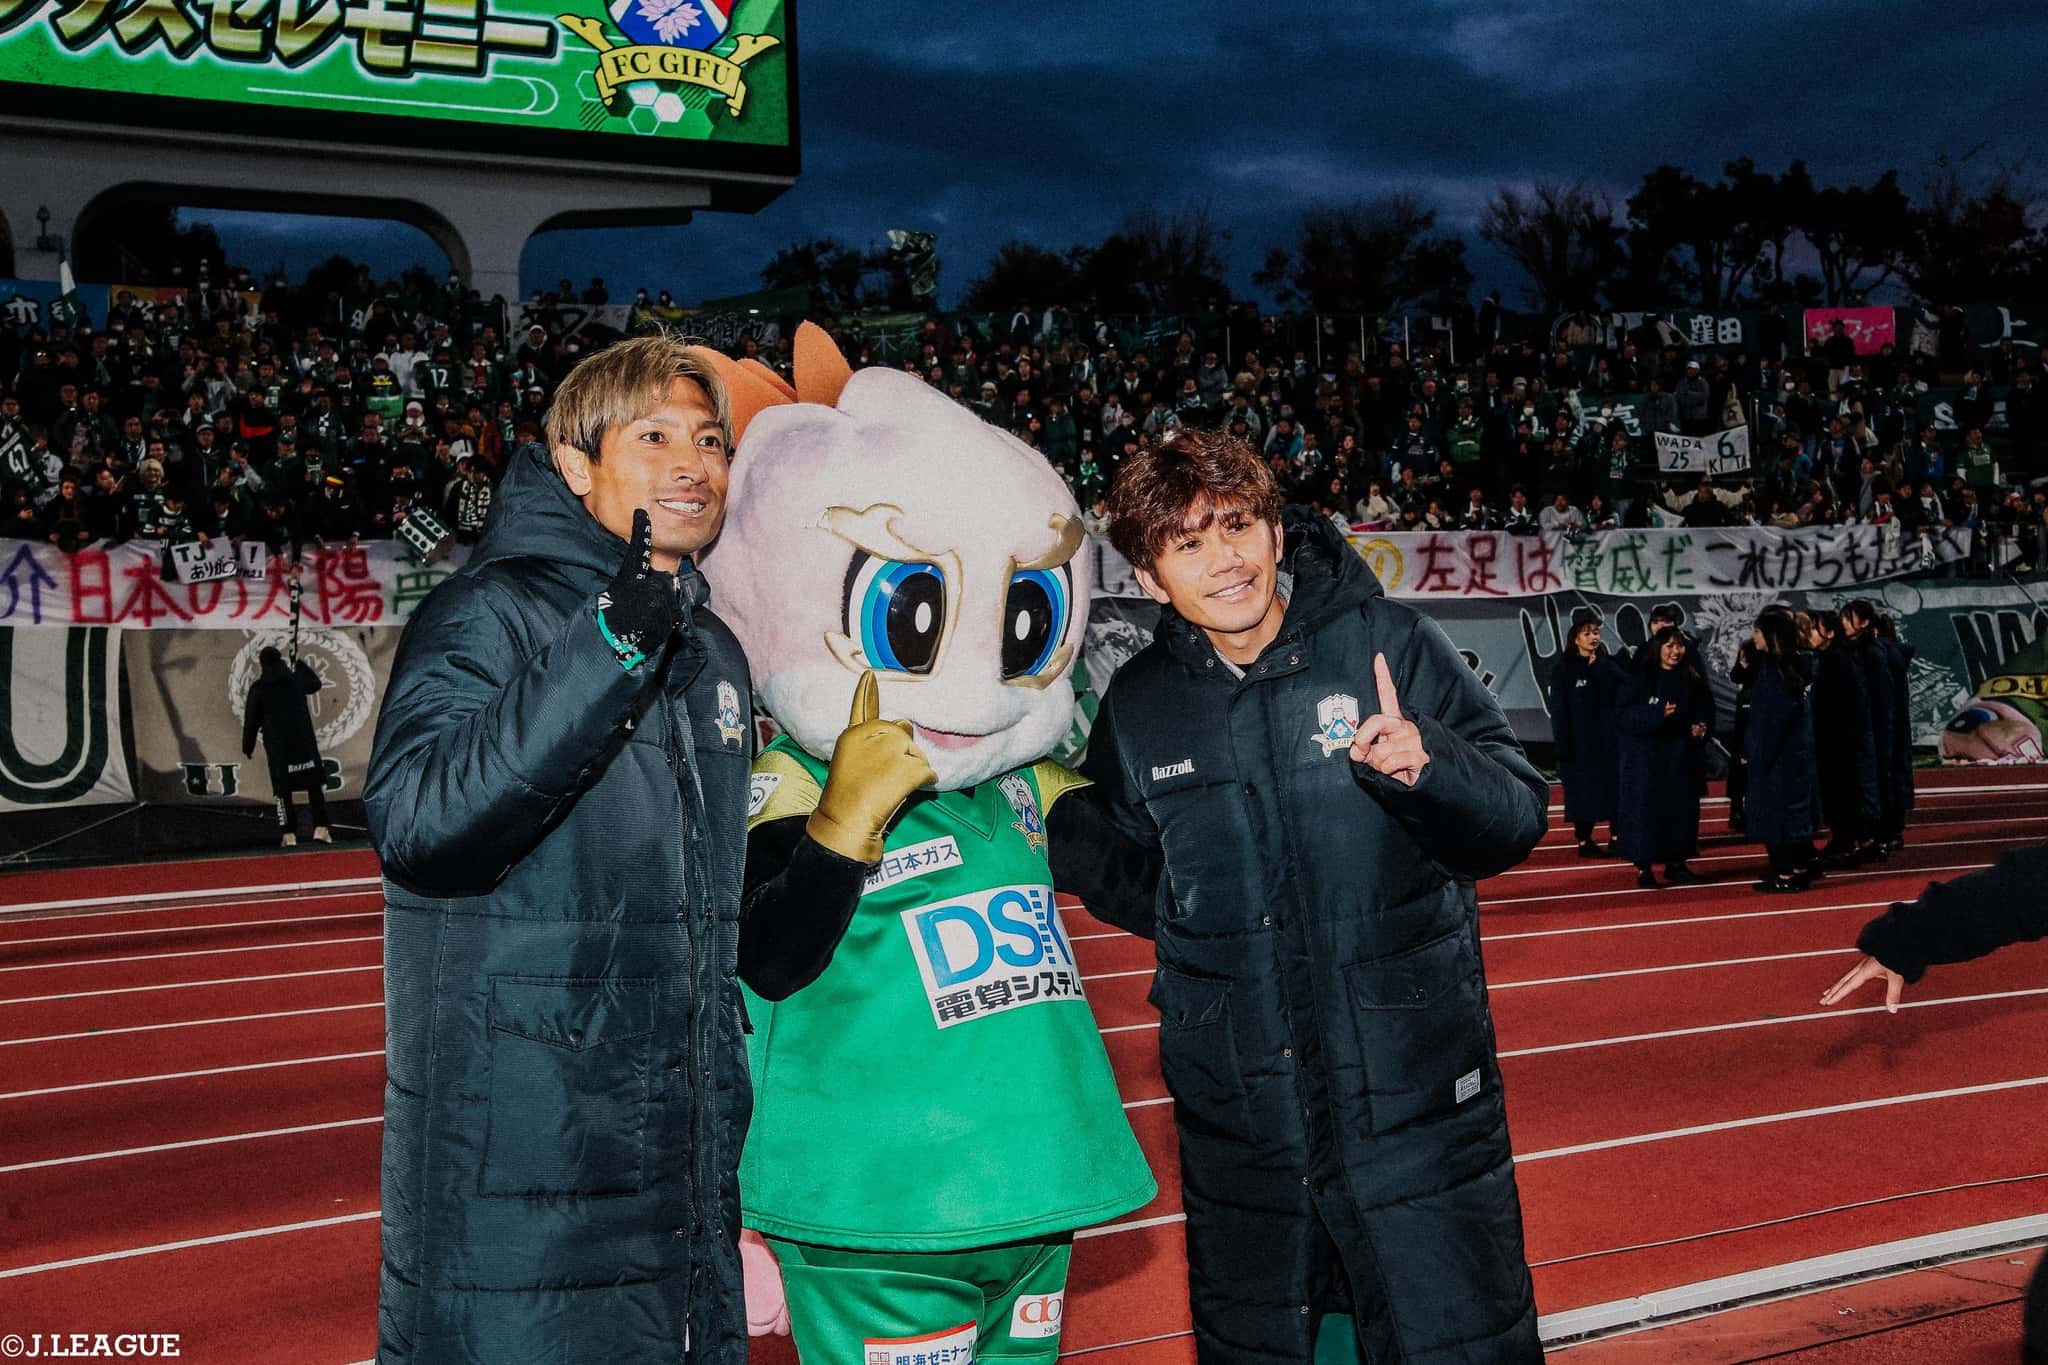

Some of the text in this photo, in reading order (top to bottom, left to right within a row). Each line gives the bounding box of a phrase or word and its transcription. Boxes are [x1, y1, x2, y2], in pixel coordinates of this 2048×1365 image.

[612, 52, 730, 86] FC GIFU
[430, 368, 449, 389] 12
[1657, 436, 1703, 450] WADA
[1717, 432, 1735, 458] 6
[1668, 451, 1690, 470] 25
[176, 543, 206, 562] TJ
